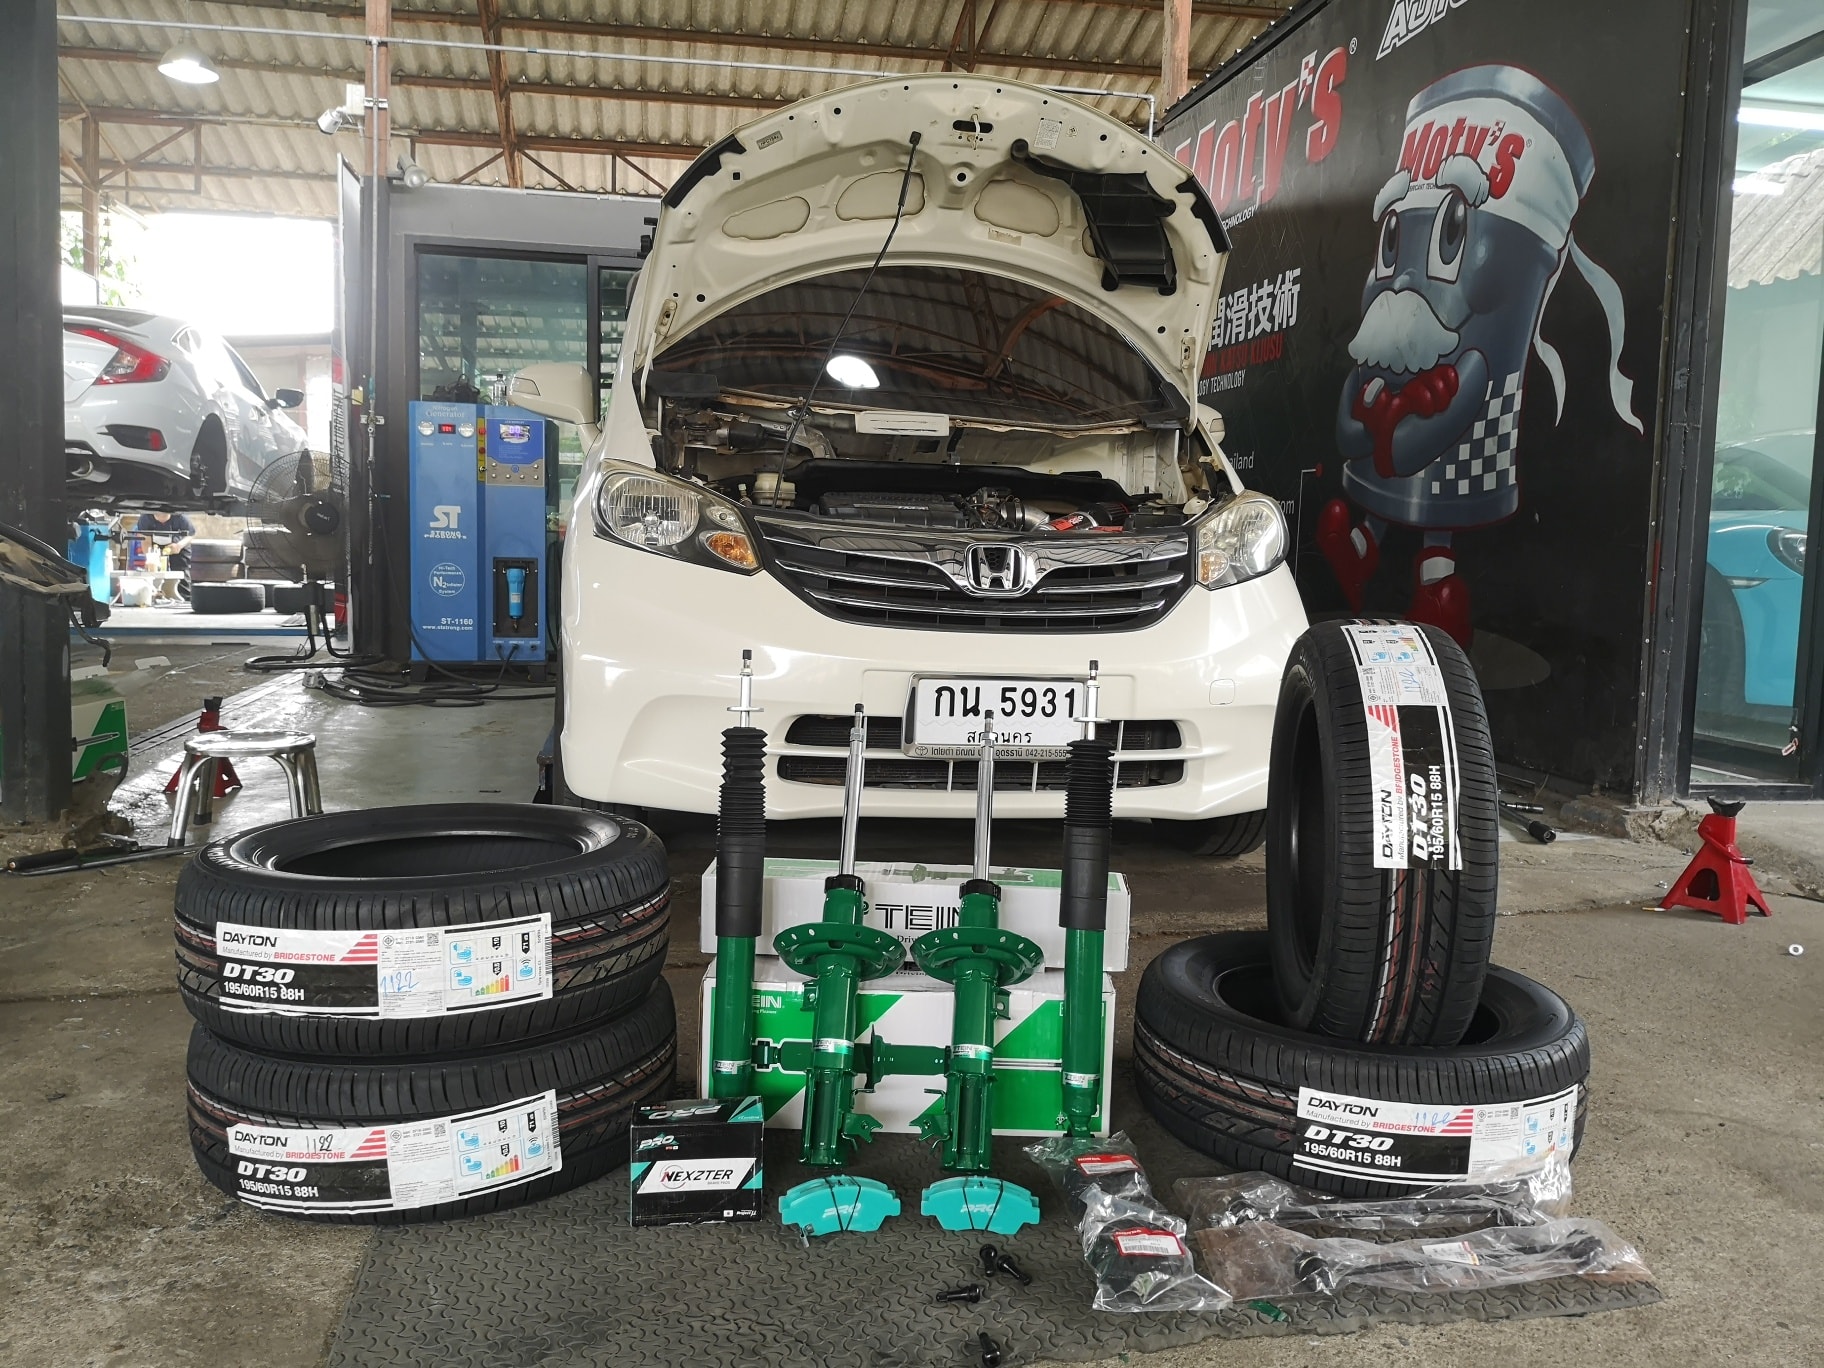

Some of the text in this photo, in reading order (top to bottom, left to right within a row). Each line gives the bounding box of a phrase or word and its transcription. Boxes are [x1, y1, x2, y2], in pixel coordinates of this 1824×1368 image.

[1210, 368, 1246, 394] TECHNOLOGY
[425, 409, 465, 419] Generator
[430, 505, 462, 529] ST
[441, 617, 473, 625] ST-1160
[934, 685, 1075, 718] กน 5931
[1391, 736, 1404, 794] BRIDGESTONE
[1410, 773, 1428, 861] DT30
[1428, 765, 1444, 861] 195/60R15 88H
[222, 931, 278, 948] DAYTON
[222, 946, 336, 962] Manufactured by BRIDGESTONE
[222, 962, 296, 984] DT30
[223, 981, 305, 1001] 195/60R15 88H
[1307, 1096, 1379, 1117] DAYTON
[1306, 1109, 1436, 1133] Manufactured by BRIDGESTONE
[234, 1131, 288, 1147] DAYTON
[639, 1135, 675, 1149] PRO
[1304, 1125, 1394, 1151] DT30
[234, 1145, 346, 1160] Manufactured by BRIDGESTONE
[1303, 1141, 1402, 1167] 195/60R15 88H
[237, 1160, 307, 1183] DT30
[660, 1169, 734, 1183] NEXZTER
[239, 1178, 319, 1198] 195/60R15 88H
[822, 1202, 862, 1219] PRO
[960, 1203, 1000, 1214] PRO
